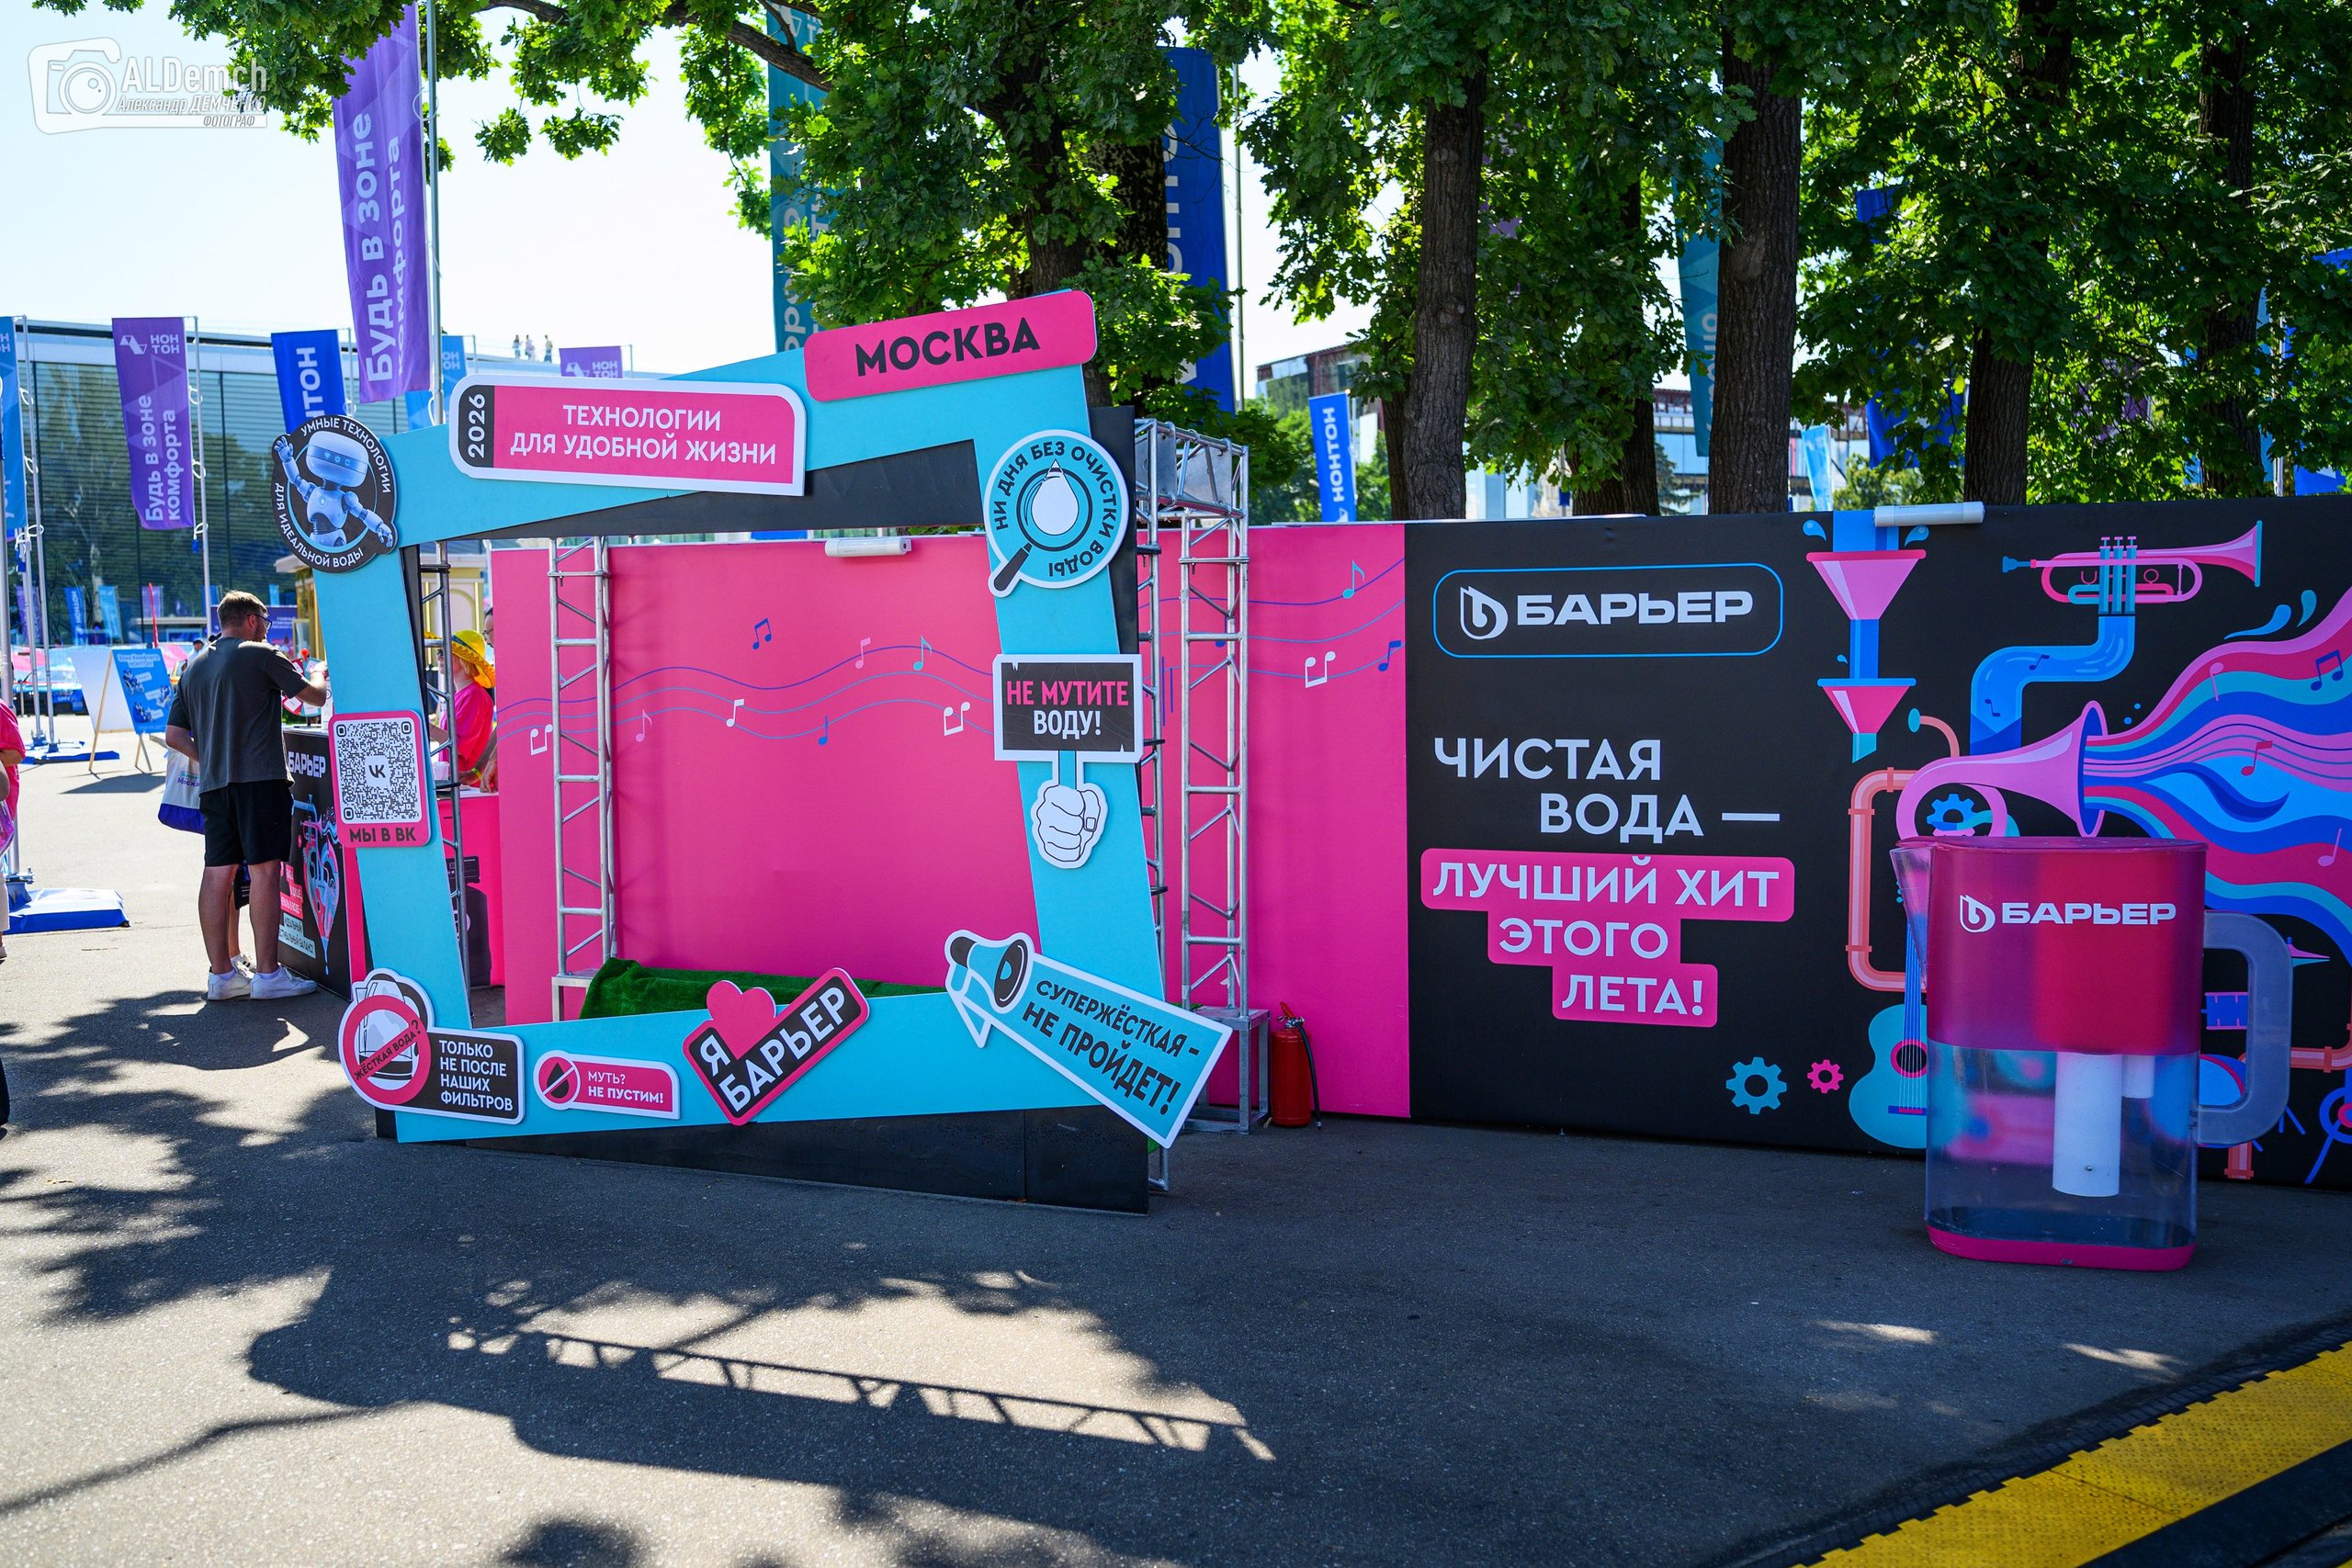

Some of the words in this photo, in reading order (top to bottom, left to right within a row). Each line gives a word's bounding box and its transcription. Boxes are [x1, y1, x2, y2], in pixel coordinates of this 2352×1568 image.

[353, 112, 380, 224] зоне
[389, 136, 407, 376] комфорта
[150, 333, 179, 344] НОН
[366, 274, 396, 382] Будь
[152, 344, 180, 355] ТОН
[442, 351, 459, 360] ОН
[855, 317, 1041, 377] МОСКВА
[442, 360, 460, 370] ОН
[592, 360, 617, 370] НОН
[138, 395, 157, 447] зоне
[468, 393, 486, 458] 2026
[562, 404, 721, 432] ТЕХНОЛОГИИ
[163, 410, 184, 520] комфорта
[300, 417, 345, 437] УМНЫЕ
[343, 419, 391, 493] ТЕХНОЛОГИИ
[510, 433, 556, 457] ДЛЯ
[564, 433, 677, 460] УДОБНОЙ
[684, 440, 776, 465] ЖИЗНИ
[1030, 441, 1065, 460] БЕЗ
[1322, 407, 1345, 502] НОНТОН
[997, 453, 1029, 497] ДНЯ
[1071, 446, 1117, 538] ОЧИСТКИ
[145, 469, 165, 521] Будь
[275, 482, 285, 511] ДЛЯ
[993, 501, 1009, 531] НИ
[278, 513, 330, 568] ИДЕАЛЬНОЙ
[333, 547, 365, 568] ВОДЫ
[1048, 539, 1105, 577] ВОДЫ
[1517, 591, 1754, 626] БАРЬЕР
[1007, 681, 1035, 705] НЕ
[1041, 681, 1129, 705] МУТИТЕ
[1034, 710, 1102, 739] ВОДУ!
[288, 750, 326, 778] БАРЬЕР
[1434, 738, 1661, 781] ЧИСТАЯ
[177, 777, 200, 787] Москв
[350, 828, 376, 842] МЫ
[381, 828, 390, 841] В
[395, 828, 416, 841] ВК
[1540, 793, 1704, 844] ВОДА
[1432, 855, 1657, 904] ЛУЧШИЙ
[1675, 869, 1780, 908] ХИТ
[2002, 902, 2177, 925] БАРЬЕР
[1498, 918, 1668, 959] ЭТОГО
[1562, 974, 1703, 1016] ЛЕТА!
[1036, 980, 1188, 1057] СУПЕРЖЁСТКАЯ
[354, 1048, 392, 1081] ЖЁСТКАЯ
[393, 1020, 422, 1053] ВОДА?
[439, 1040, 493, 1058] ТОЛЬКО
[699, 1034, 731, 1077] Я
[718, 987, 845, 1113] БАРЬЕР
[1022, 1001, 1060, 1039] НЕ
[1058, 1022, 1182, 1115] ПРОЙДЕТ!
[440, 1057, 457, 1071] НЕ
[461, 1059, 506, 1077] ПОСЛЕ
[440, 1074, 491, 1092] НАШИХ
[587, 1071, 626, 1085] МУТЬ?
[440, 1089, 514, 1111] ФИЛЬТРОВ
[588, 1086, 605, 1099] НЕ
[607, 1087, 664, 1104] ПУСТИМ!
